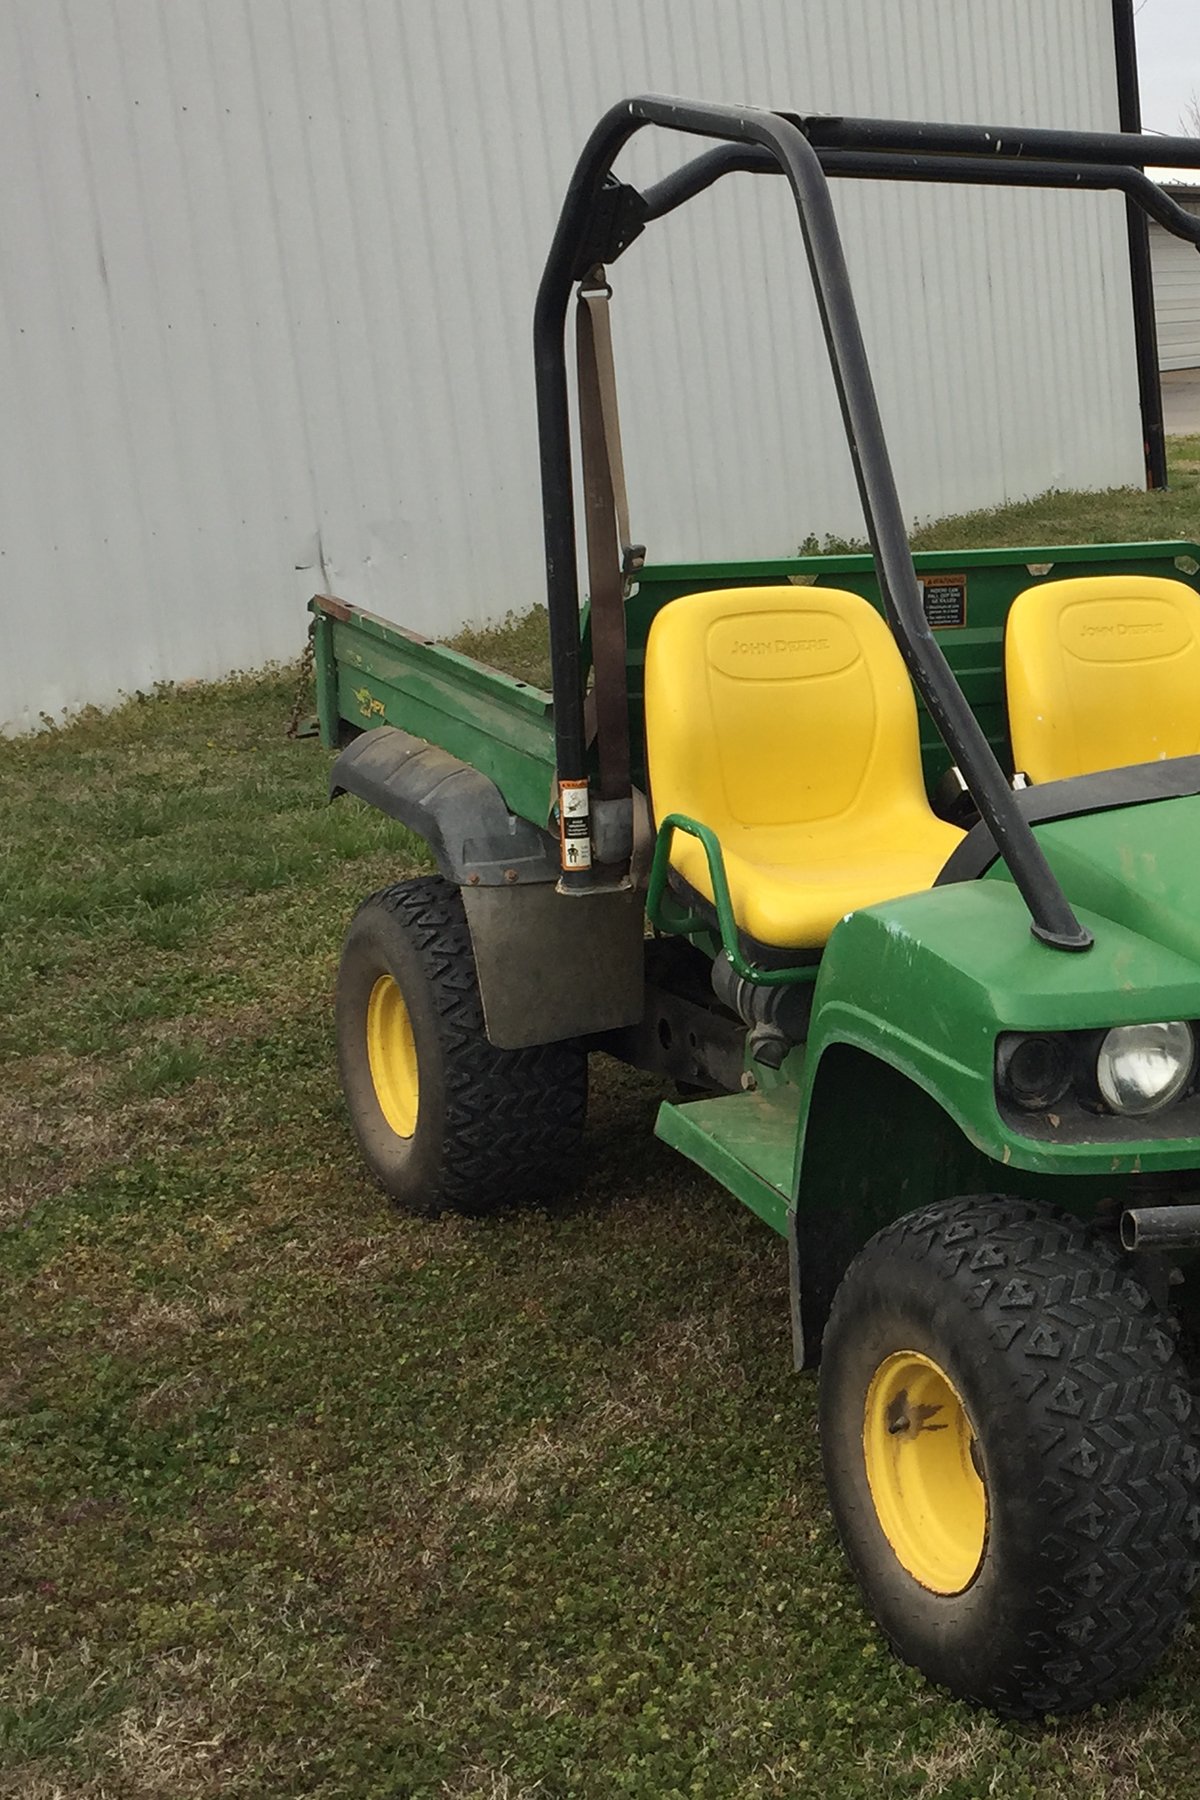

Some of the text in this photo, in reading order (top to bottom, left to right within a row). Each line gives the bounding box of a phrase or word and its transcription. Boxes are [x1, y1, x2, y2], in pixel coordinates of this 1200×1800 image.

[1080, 624, 1114, 636] JOHN
[731, 638, 831, 655] JOHN DEERE
